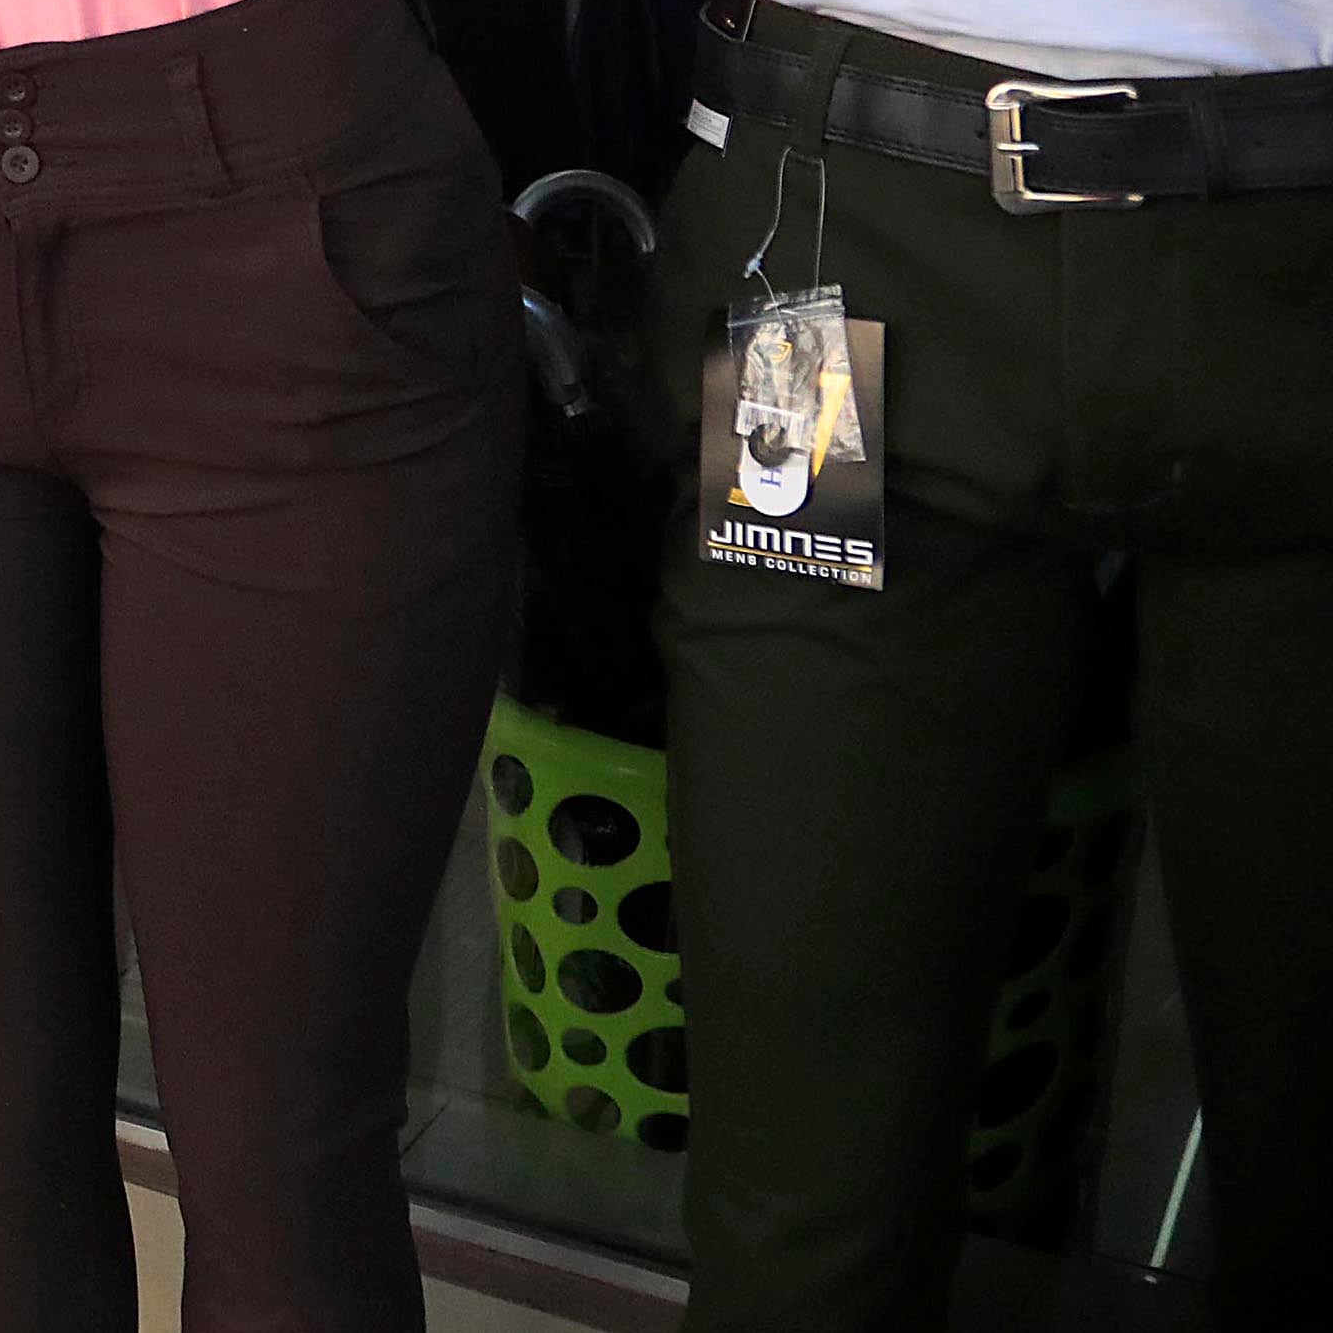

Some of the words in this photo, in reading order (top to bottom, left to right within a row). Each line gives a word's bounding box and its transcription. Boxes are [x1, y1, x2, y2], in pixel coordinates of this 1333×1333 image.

[709, 519, 874, 566] JIMNES
[711, 549, 757, 566] MENS
[765, 557, 873, 584] COLLECTION
